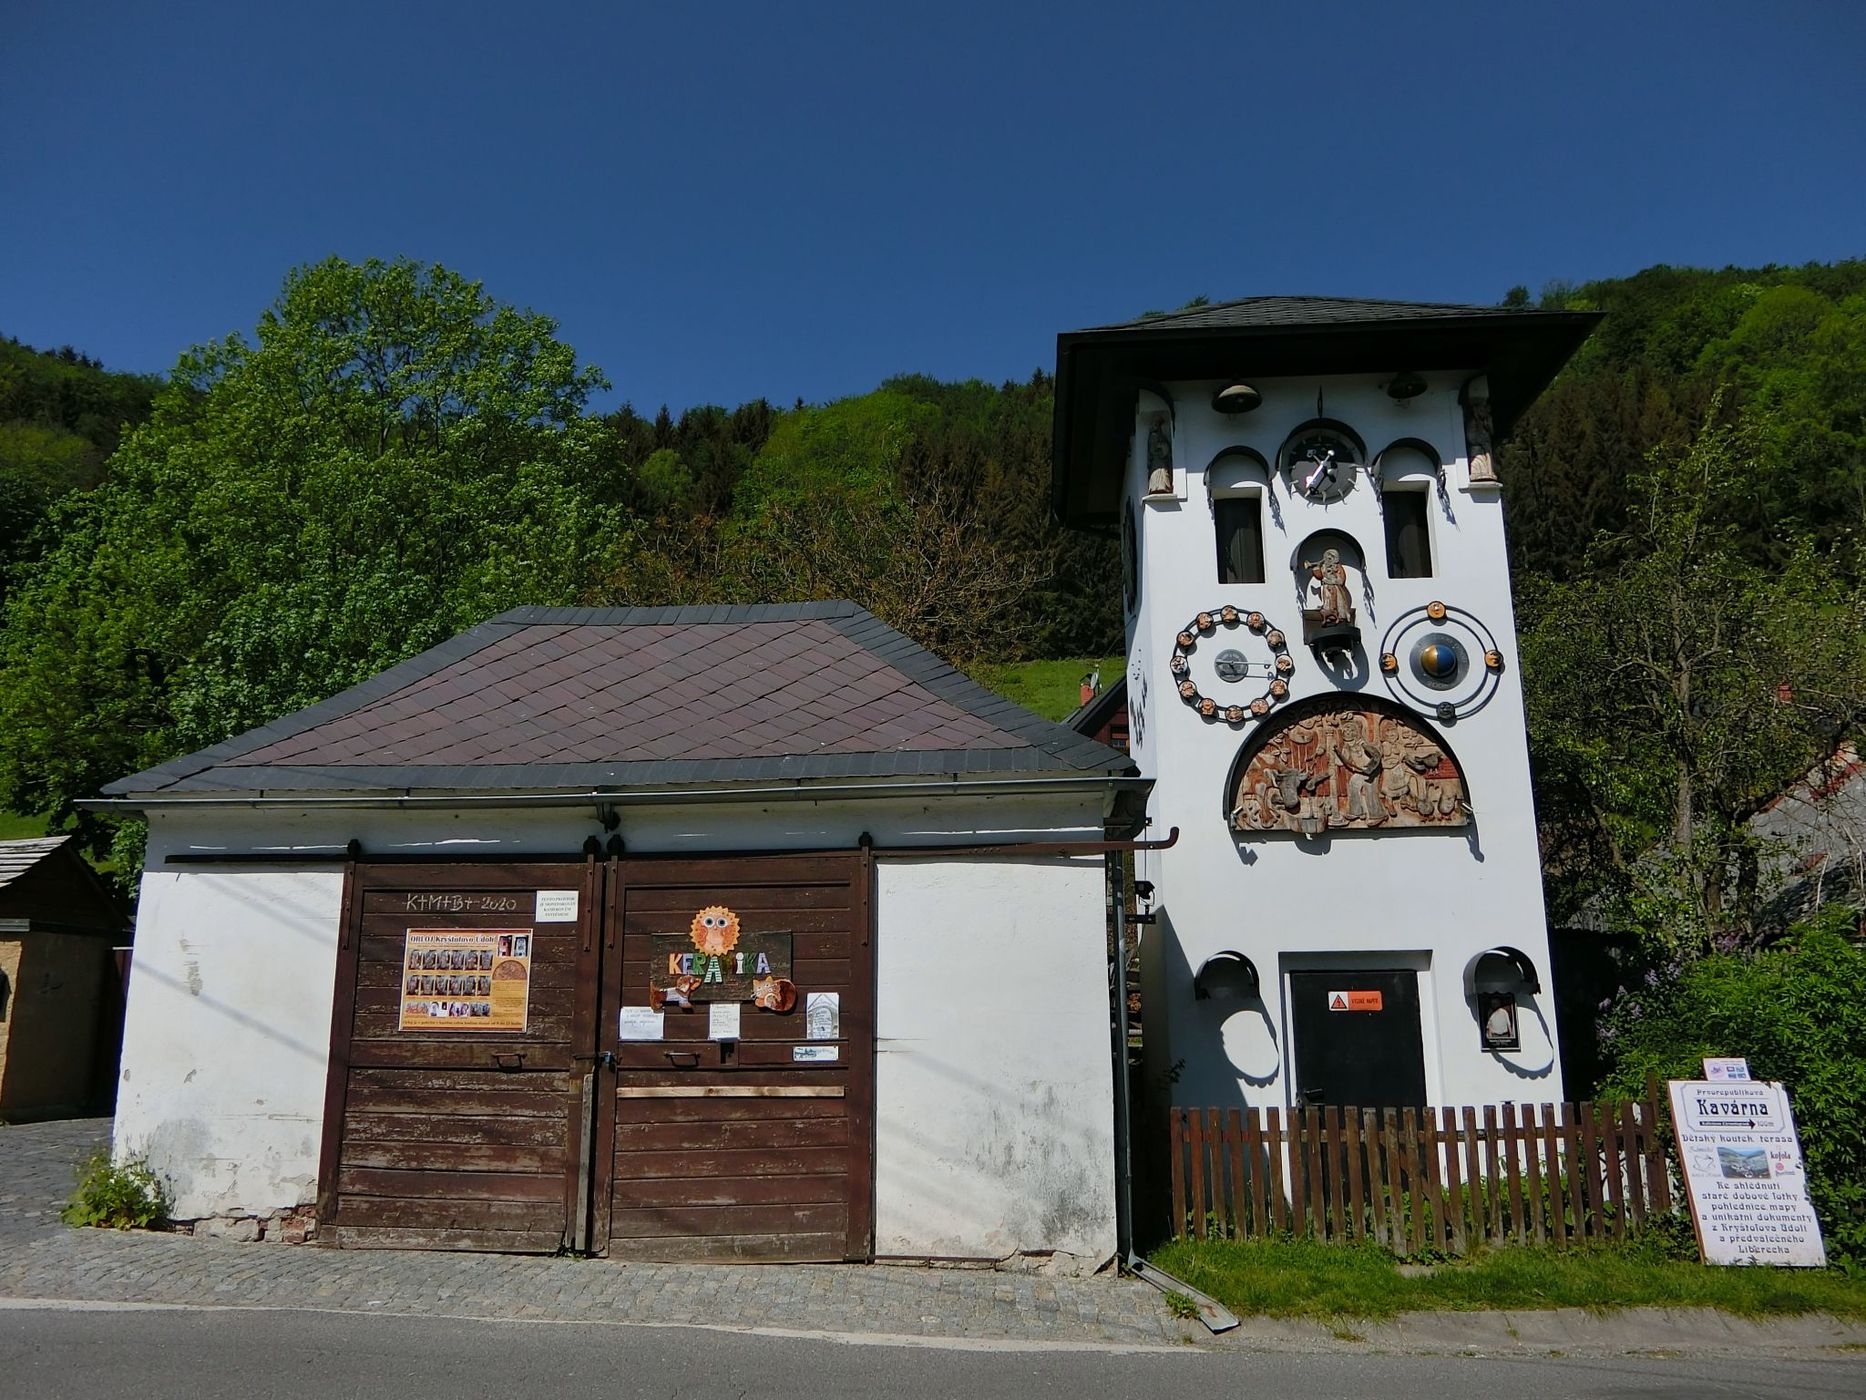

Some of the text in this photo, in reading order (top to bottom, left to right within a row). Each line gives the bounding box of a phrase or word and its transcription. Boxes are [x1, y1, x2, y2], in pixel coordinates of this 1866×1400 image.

[481, 896, 517, 911] 2020
[1696, 1099, 1769, 1116] Kavárna
[1760, 1135, 1793, 1143] terasa
[1716, 1181, 1730, 1190] Ke
[1711, 1203, 1797, 1212] pohlednice mapy
[1757, 1214, 1812, 1222] dokumenty
